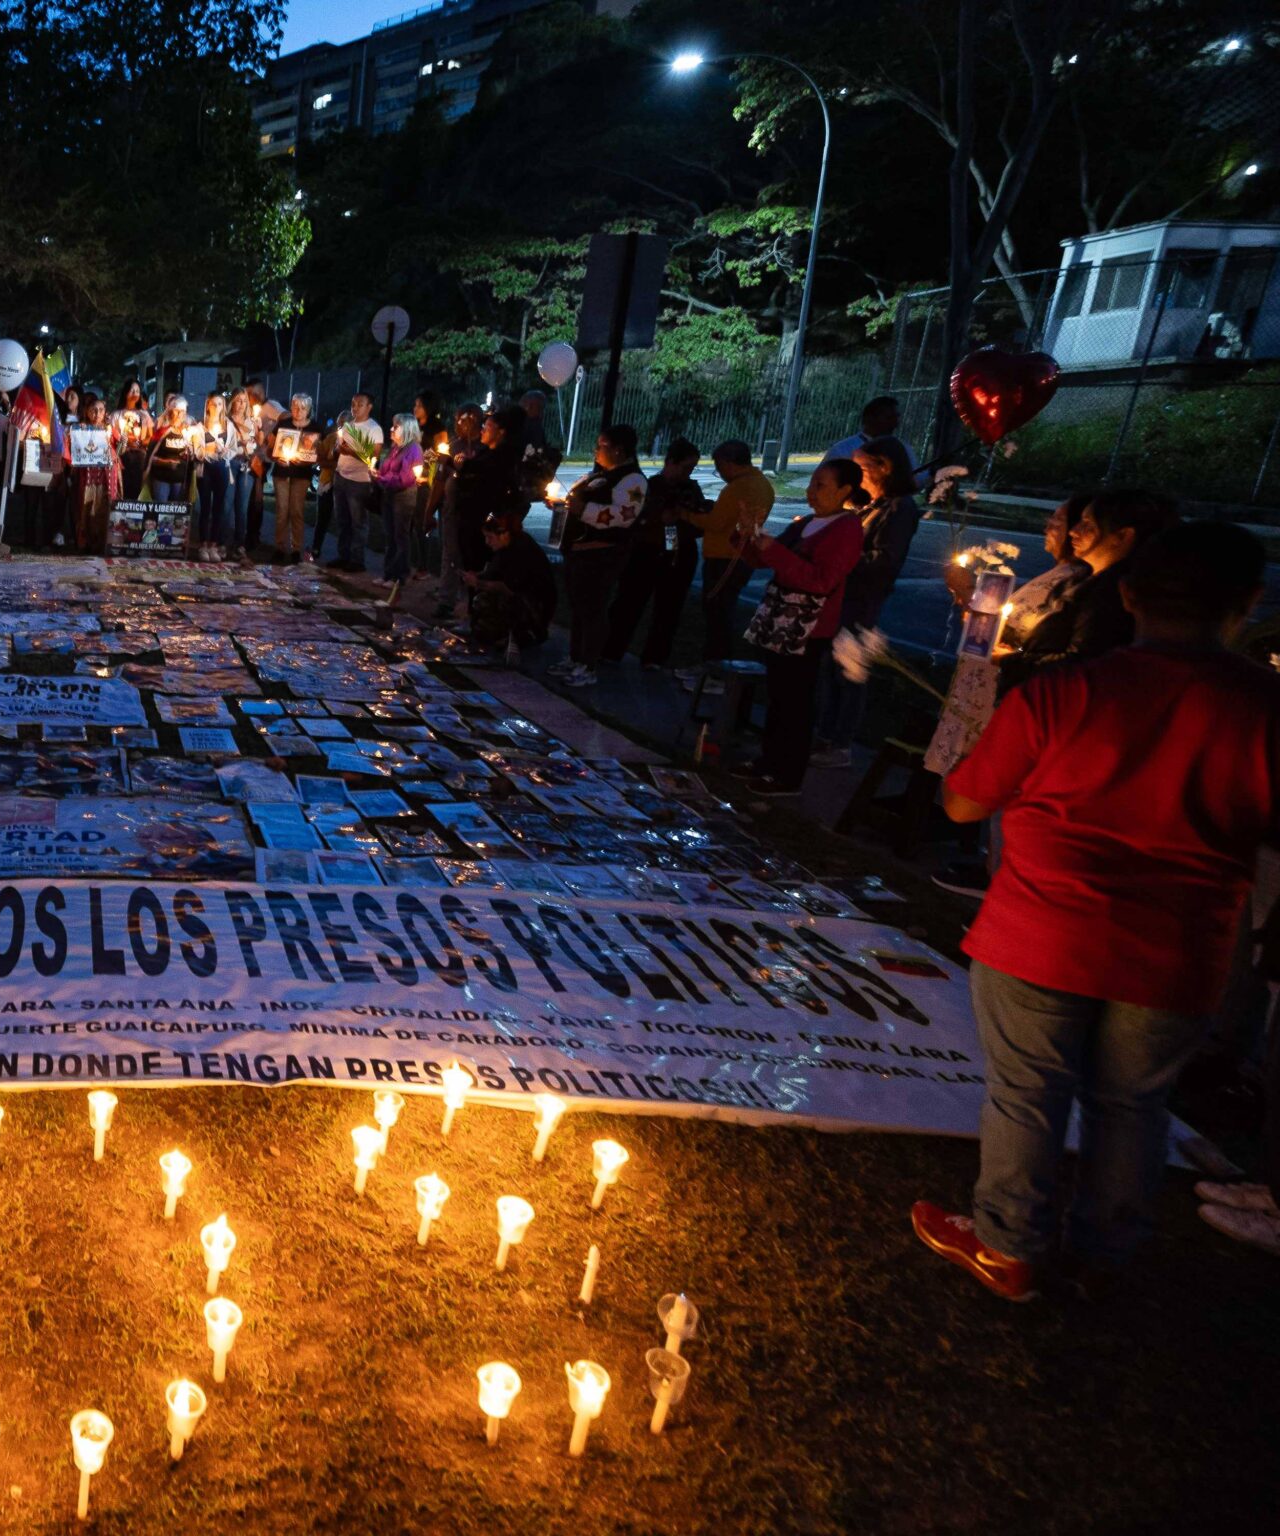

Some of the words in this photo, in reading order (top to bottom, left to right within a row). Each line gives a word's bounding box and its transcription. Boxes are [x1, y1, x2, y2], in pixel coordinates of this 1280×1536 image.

[115, 502, 147, 512] JUSTICIA
[148, 503, 154, 512] Y
[154, 503, 187, 513] LIBERTAD
[89, 885, 218, 978] LOS
[223, 889, 519, 993] PRESOS
[488, 897, 931, 1027] POLITICOS
[79, 998, 172, 1011] SANTA
[178, 999, 235, 1011] ANA
[538, 1015, 616, 1031] YARE
[638, 1019, 778, 1044] TOCORON
[798, 1031, 886, 1054] FENIX
[889, 1042, 972, 1064] LARA
[85, 1020, 267, 1034] GUAICAIPURO
[289, 1021, 386, 1040] MINIMA
[395, 1028, 431, 1042] DE
[436, 1031, 585, 1050] CARABOBO
[32, 1051, 163, 1078] DONDE
[172, 1052, 337, 1082] TENGAN
